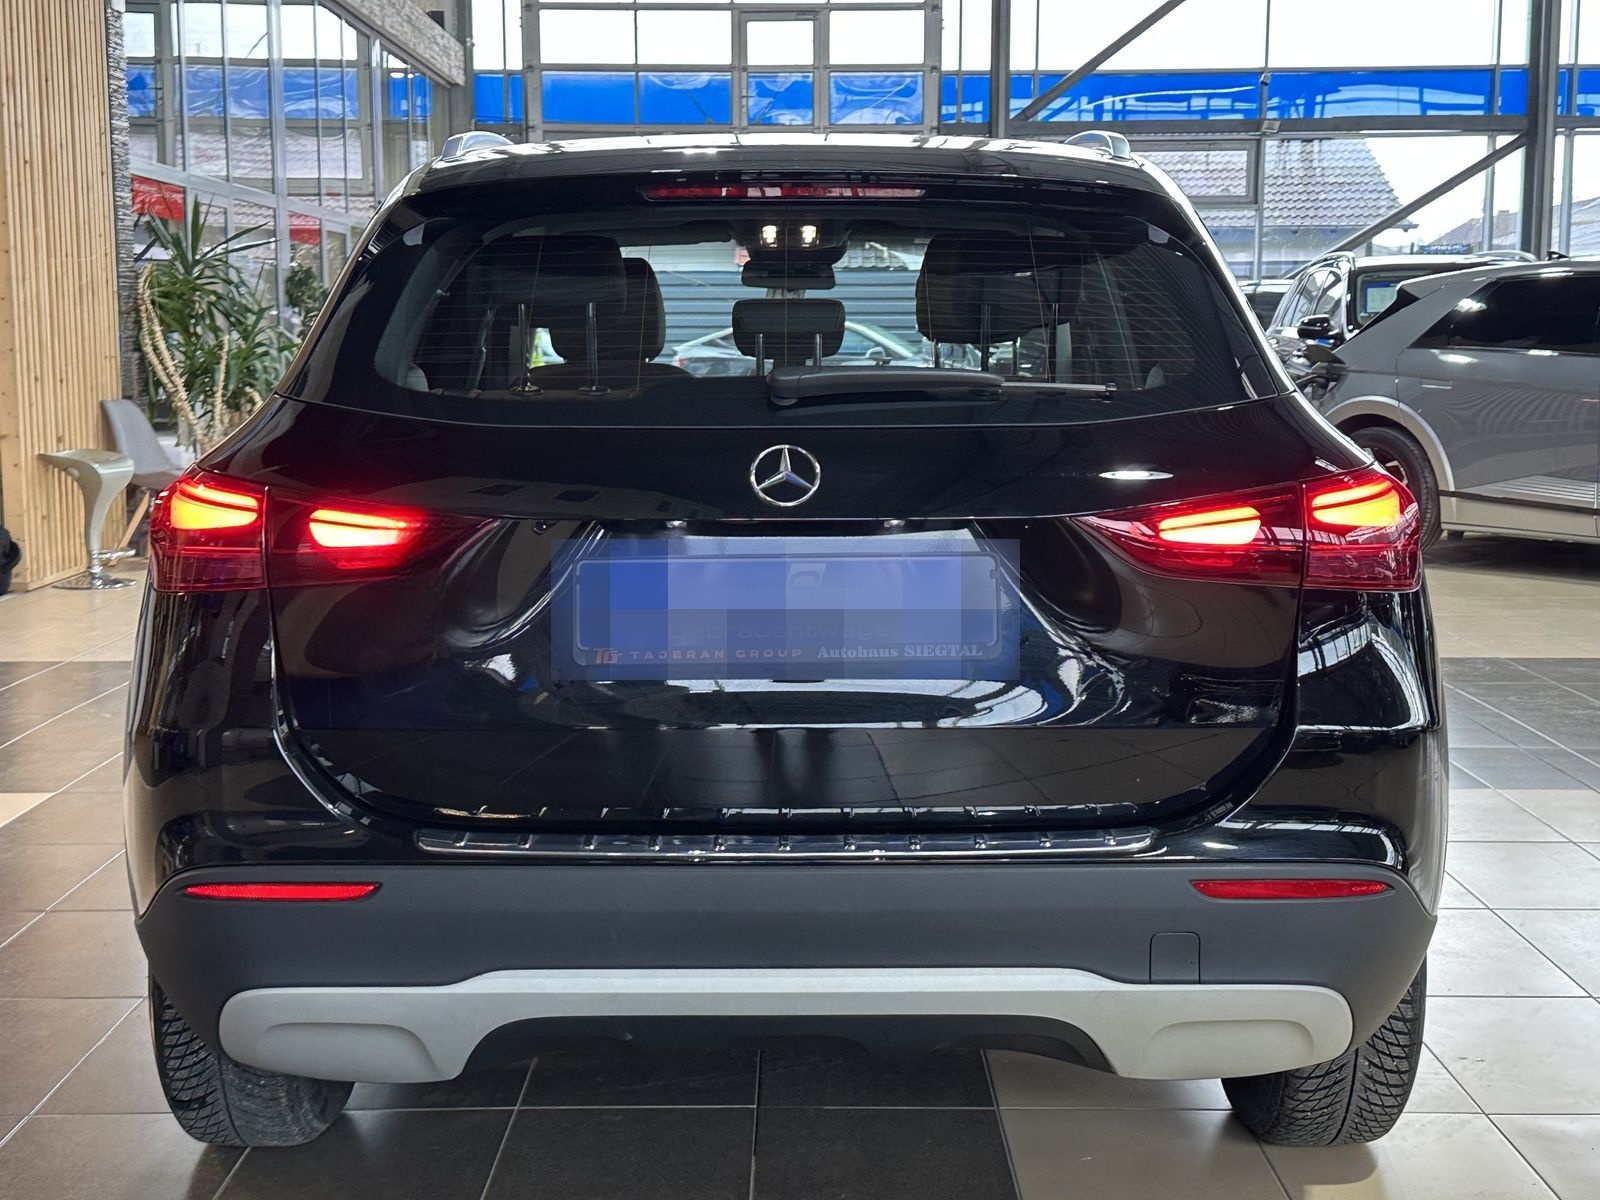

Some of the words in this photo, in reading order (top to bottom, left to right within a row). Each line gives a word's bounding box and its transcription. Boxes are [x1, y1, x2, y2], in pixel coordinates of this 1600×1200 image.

[669, 623, 904, 641] Gebrauchtwagen
[630, 649, 726, 660] TAJERAN
[735, 648, 803, 660] GROUP
[816, 645, 899, 659] Autohaus
[903, 644, 983, 658] SIEGTAL
